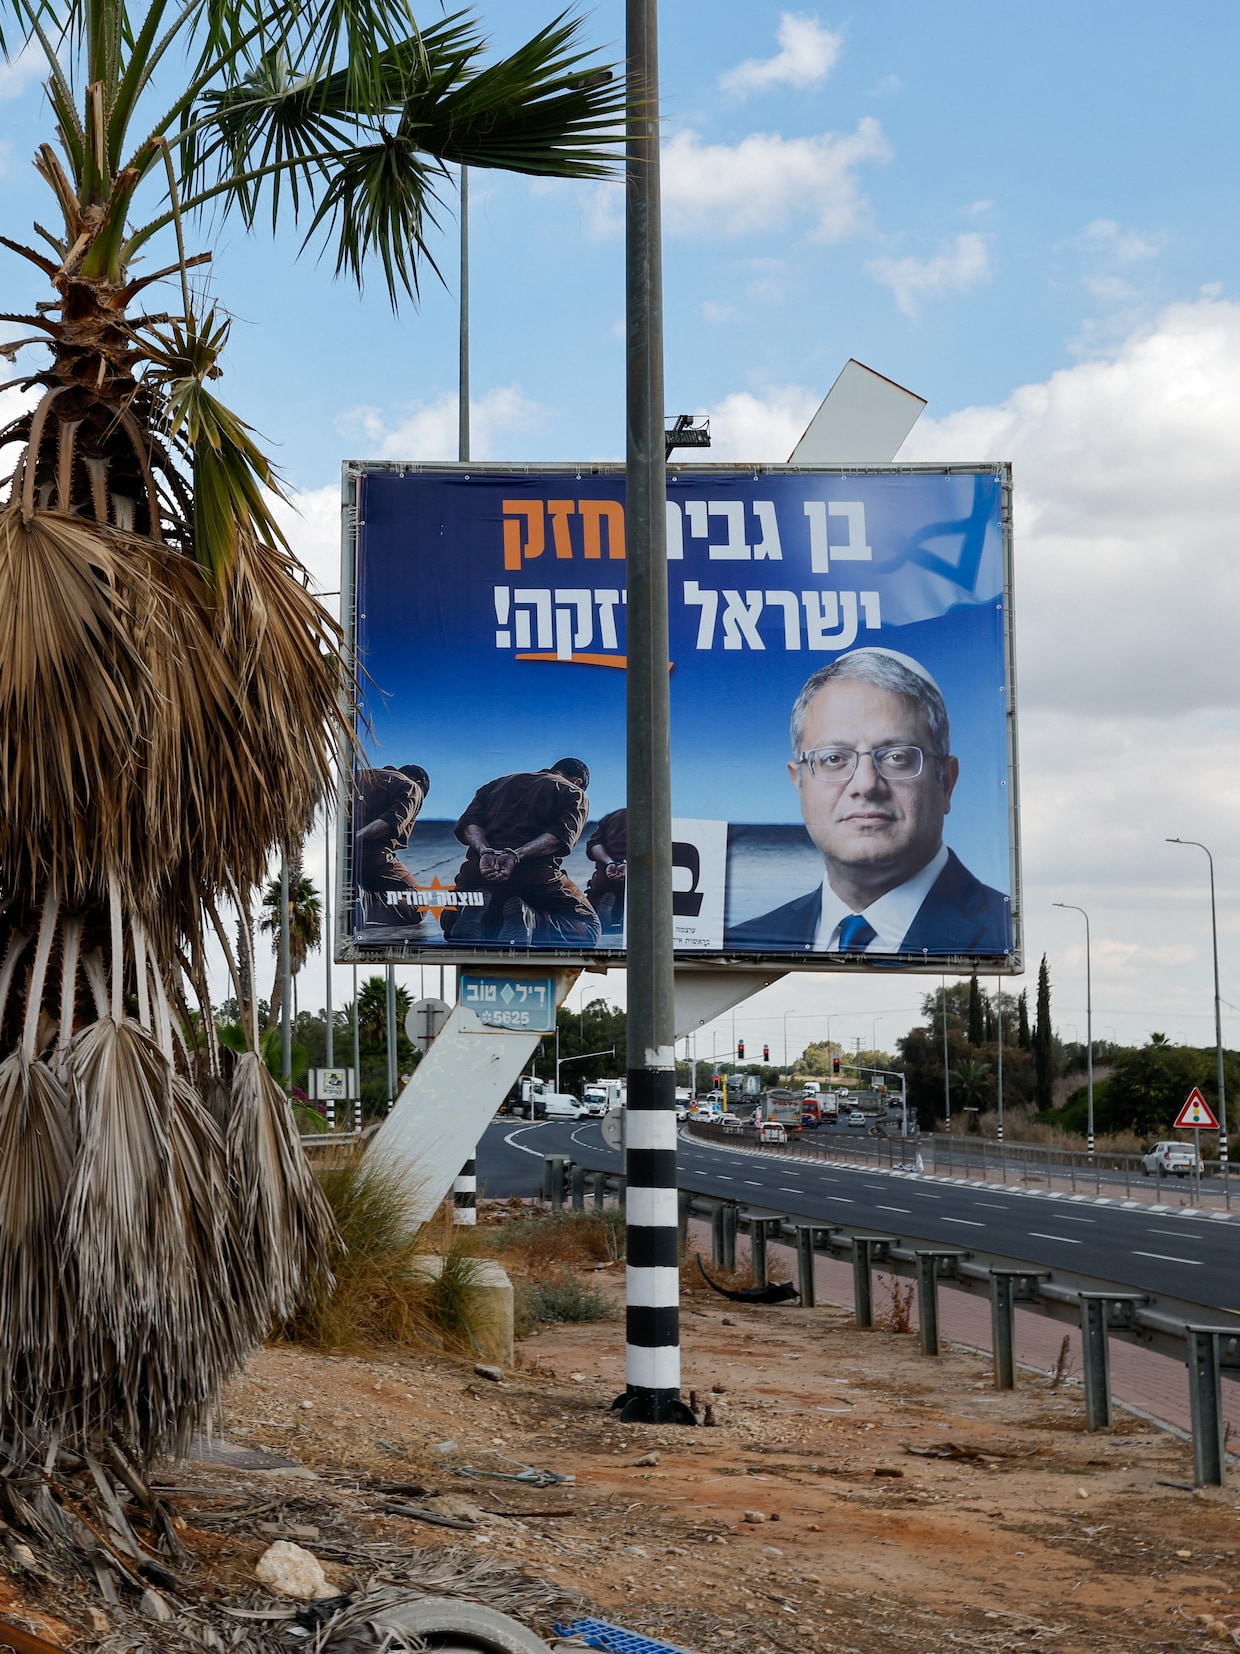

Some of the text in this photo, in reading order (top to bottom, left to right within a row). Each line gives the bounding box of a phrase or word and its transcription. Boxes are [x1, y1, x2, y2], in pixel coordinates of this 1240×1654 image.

[502, 500, 626, 571] חזק
[804, 500, 872, 573] בן
[494, 580, 882, 660] ישראל זקה!
[386, 890, 485, 907] עוצמה יהודית
